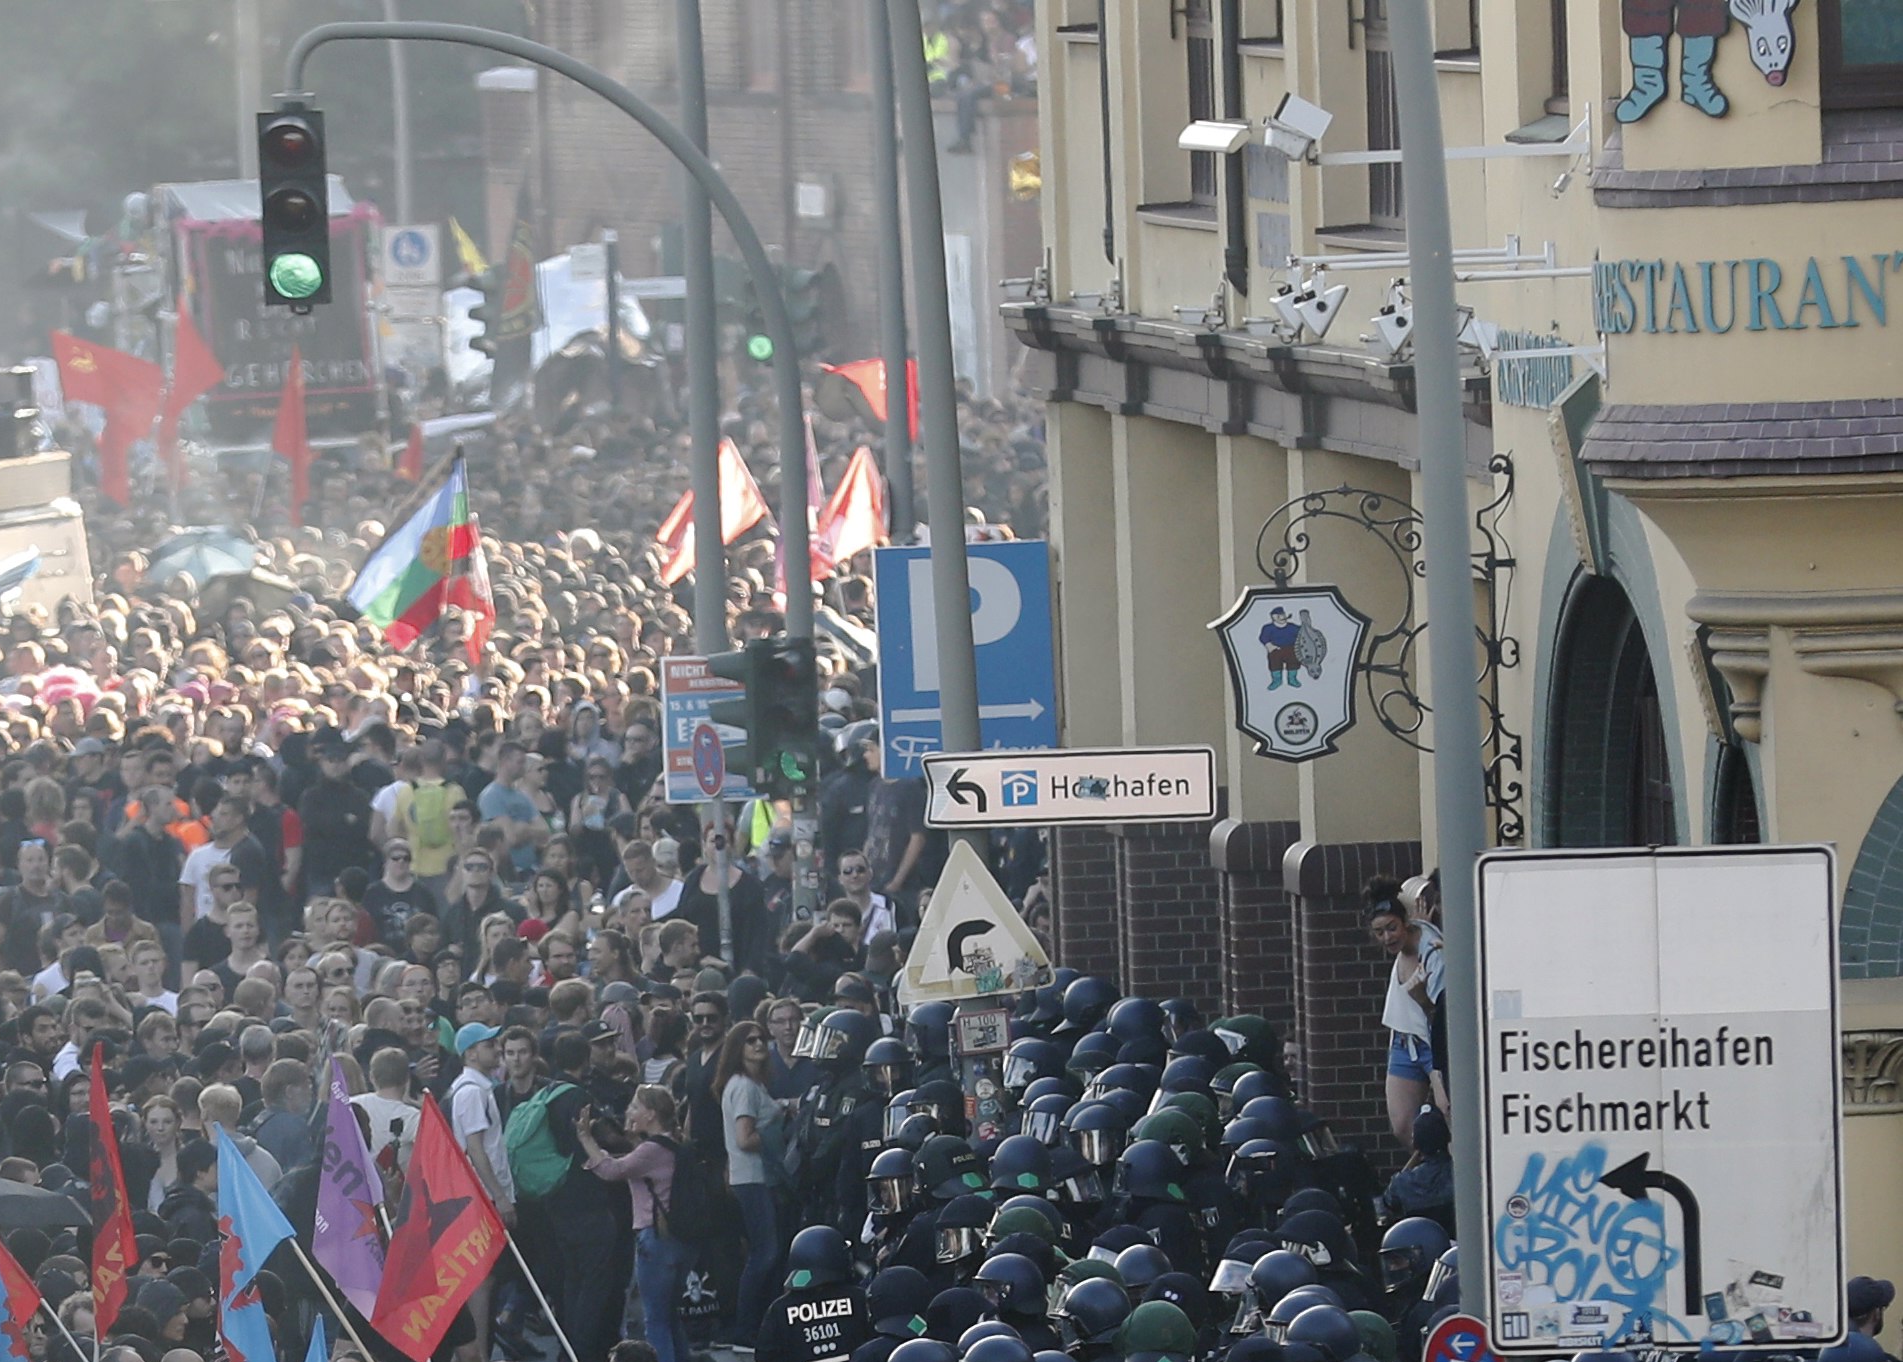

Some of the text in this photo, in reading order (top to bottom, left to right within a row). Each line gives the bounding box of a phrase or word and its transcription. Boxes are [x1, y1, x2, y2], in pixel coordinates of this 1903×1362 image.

[1500, 1026, 1774, 1073] Fischereihafen
[1501, 1089, 1711, 1135] Fischmarkt
[786, 1298, 853, 1325] POLIZEI
[803, 1322, 842, 1343] 36101
